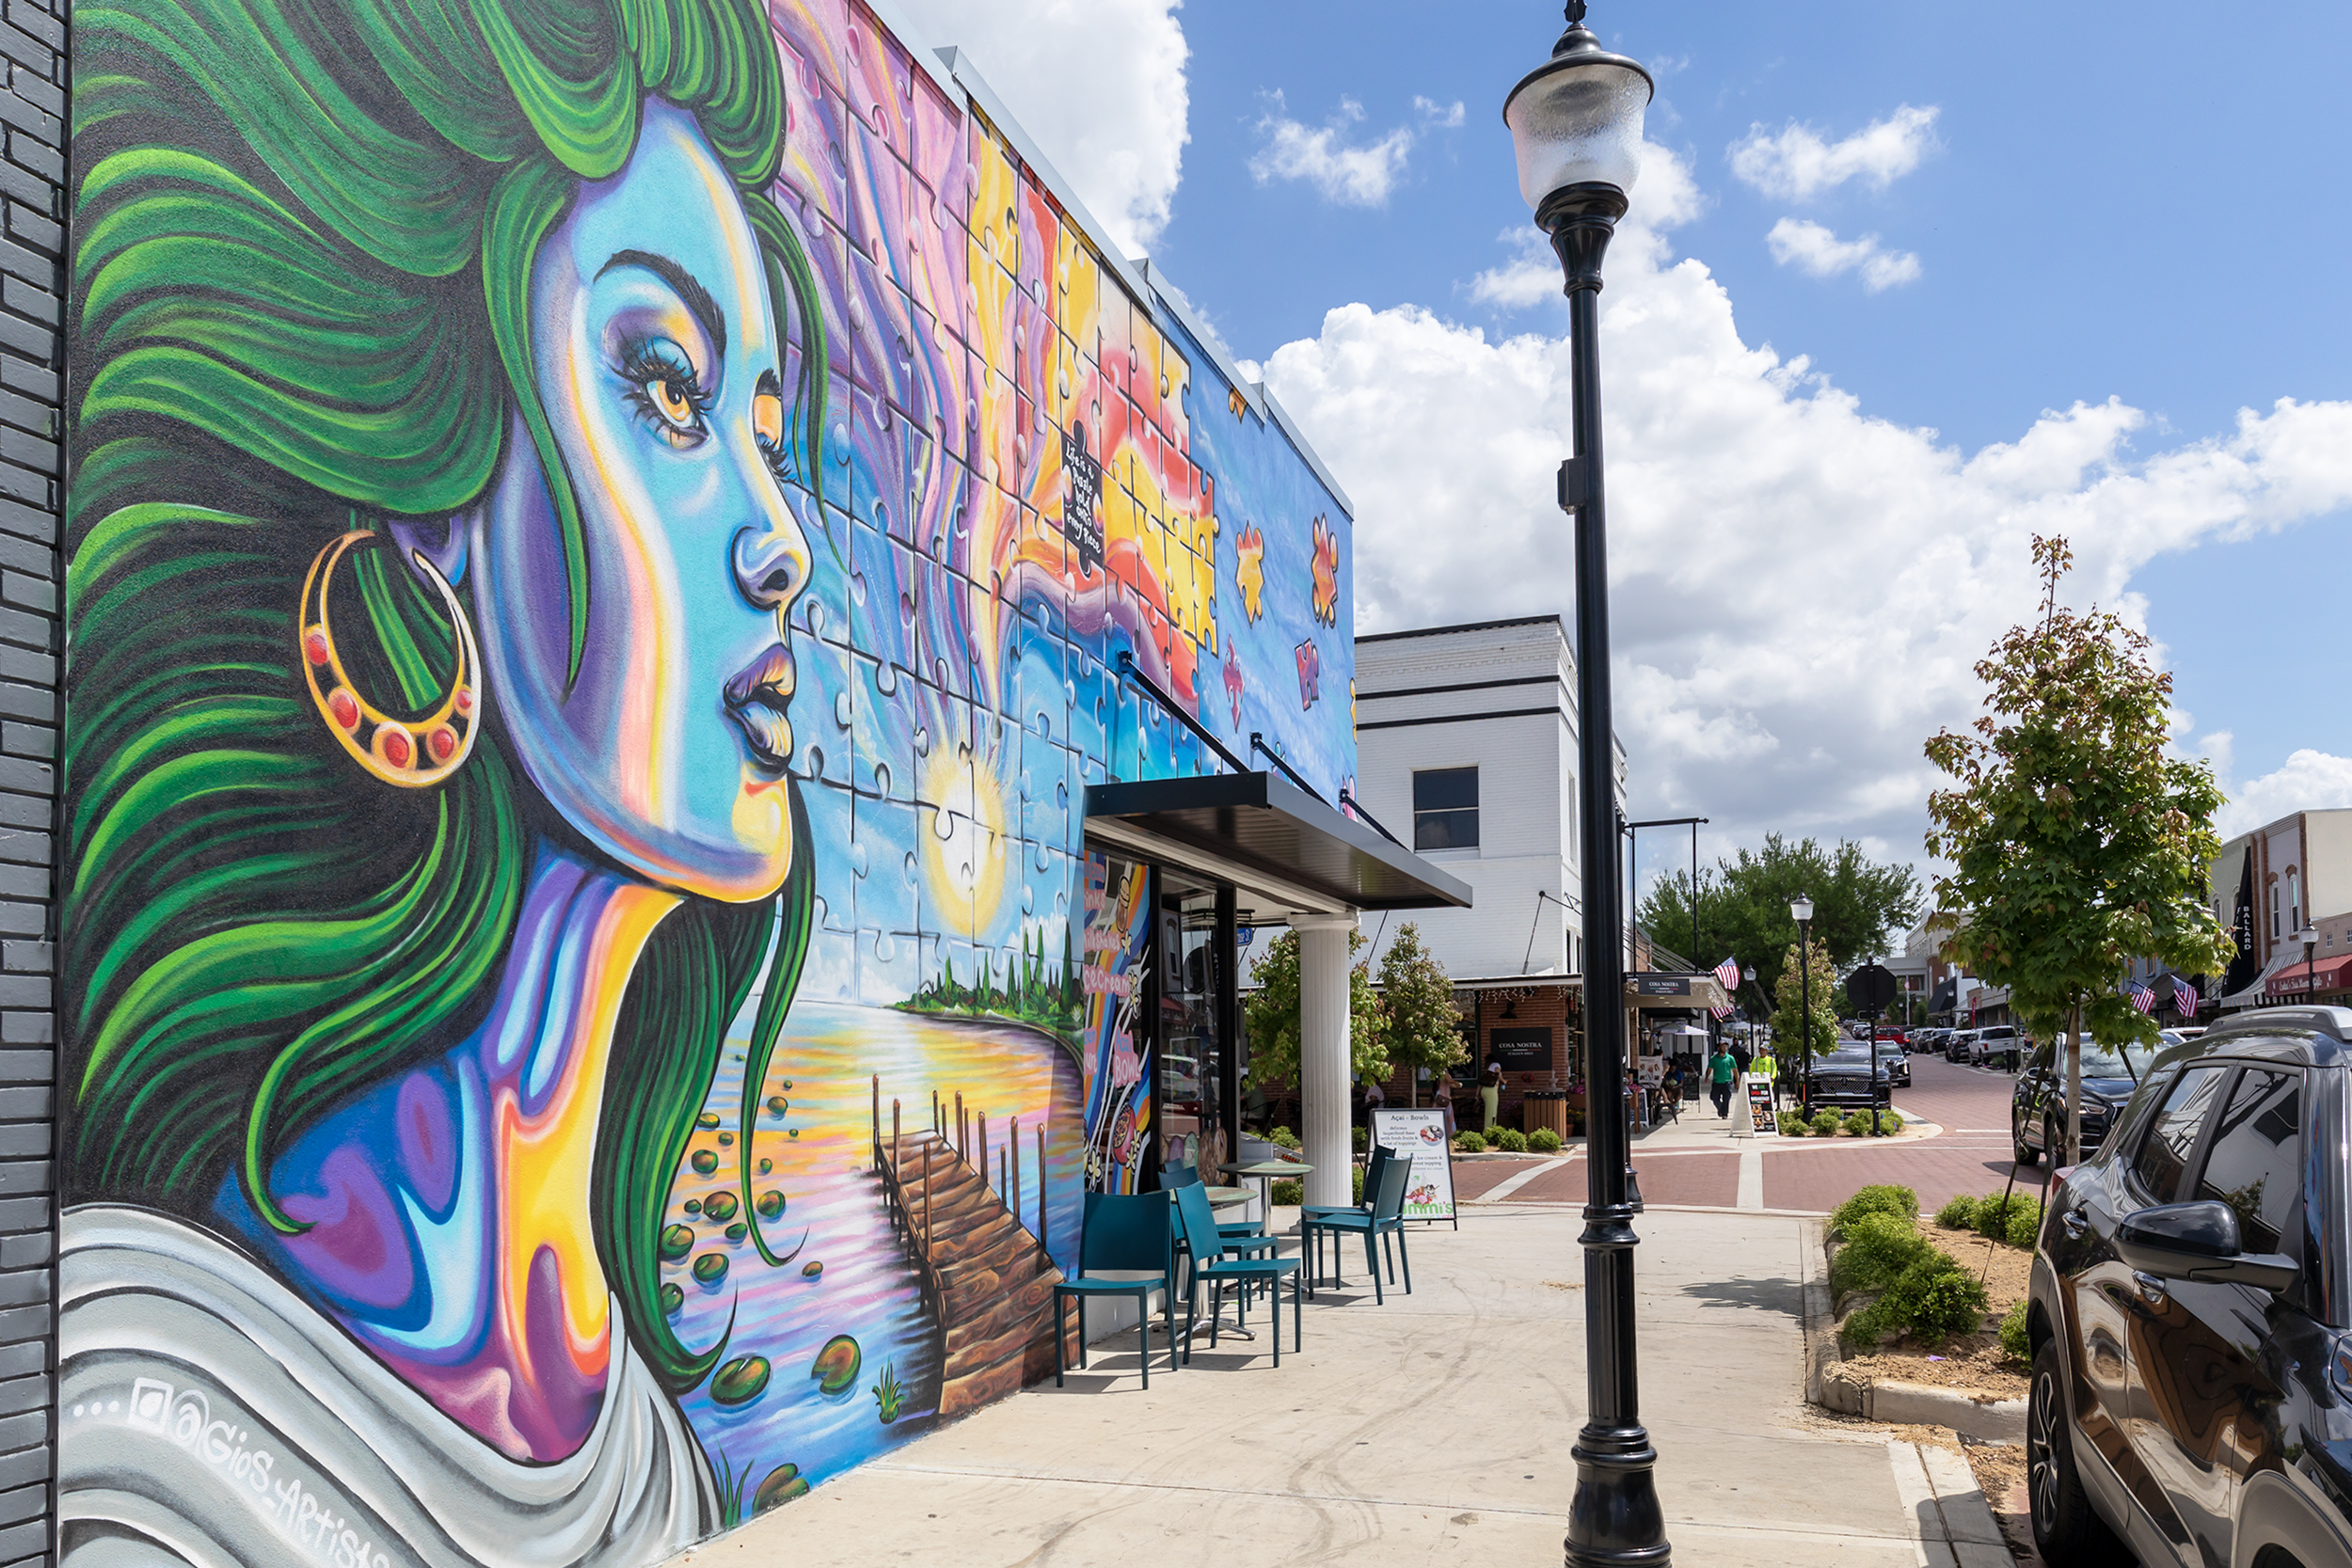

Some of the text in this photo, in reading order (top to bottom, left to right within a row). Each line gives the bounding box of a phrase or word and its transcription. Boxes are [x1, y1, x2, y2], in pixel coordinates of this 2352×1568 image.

[1088, 465, 1094, 479] a
[2243, 906, 2251, 950] BALLARD
[1115, 1054, 1140, 1083] BOWL
